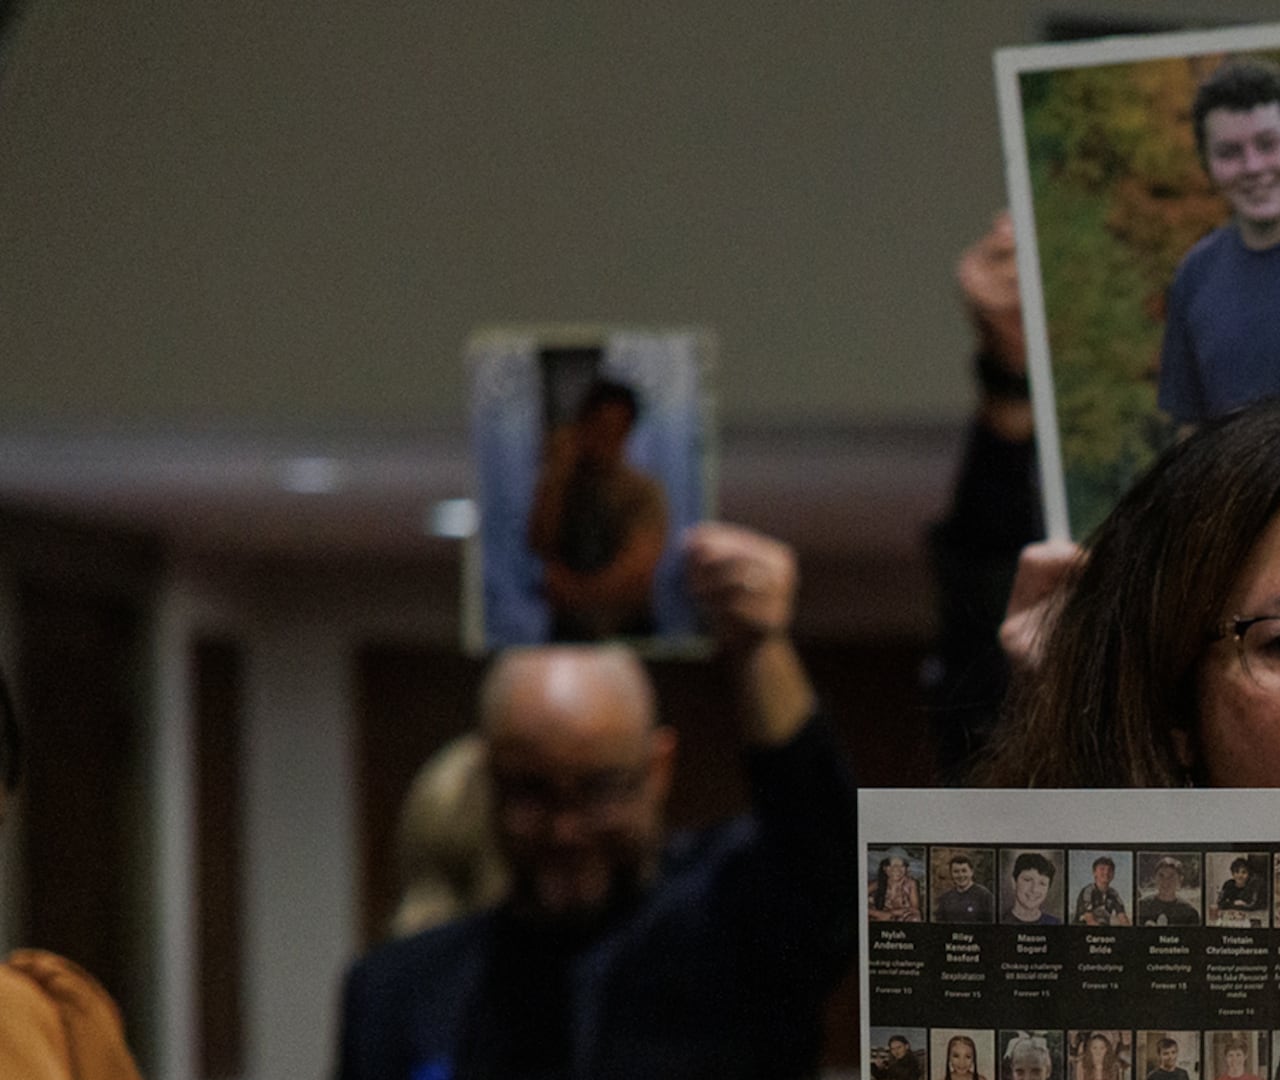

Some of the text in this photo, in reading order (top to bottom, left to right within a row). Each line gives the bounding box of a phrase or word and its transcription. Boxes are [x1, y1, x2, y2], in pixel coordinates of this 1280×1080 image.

[952, 933, 974, 942] Riley
[1017, 934, 1047, 943] Mason
[1086, 935, 1116, 944] Carson
[1159, 935, 1180, 944] Nate
[873, 942, 914, 951] Anderson
[1090, 945, 1113, 954] Bride
